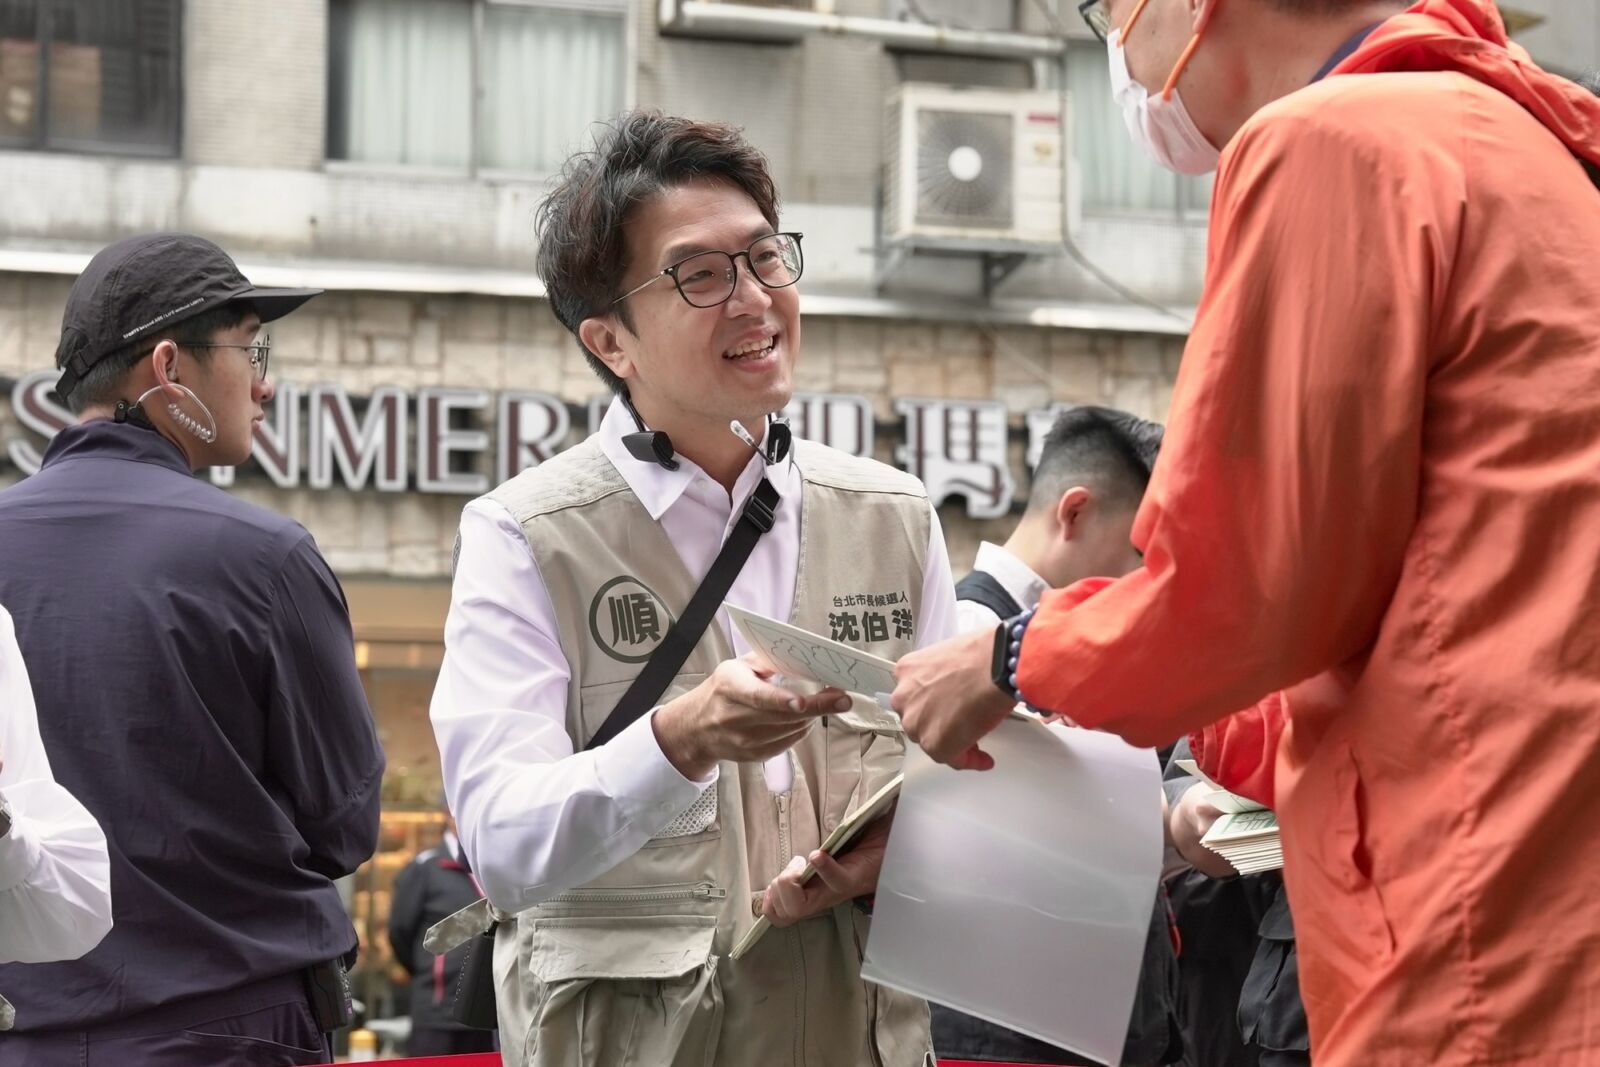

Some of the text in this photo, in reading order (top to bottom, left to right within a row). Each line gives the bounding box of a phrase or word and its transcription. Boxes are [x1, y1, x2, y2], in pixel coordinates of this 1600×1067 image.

[832, 591, 909, 607] 台北市長候選人
[607, 592, 661, 648] 順
[828, 608, 913, 642] 沈伯洋
